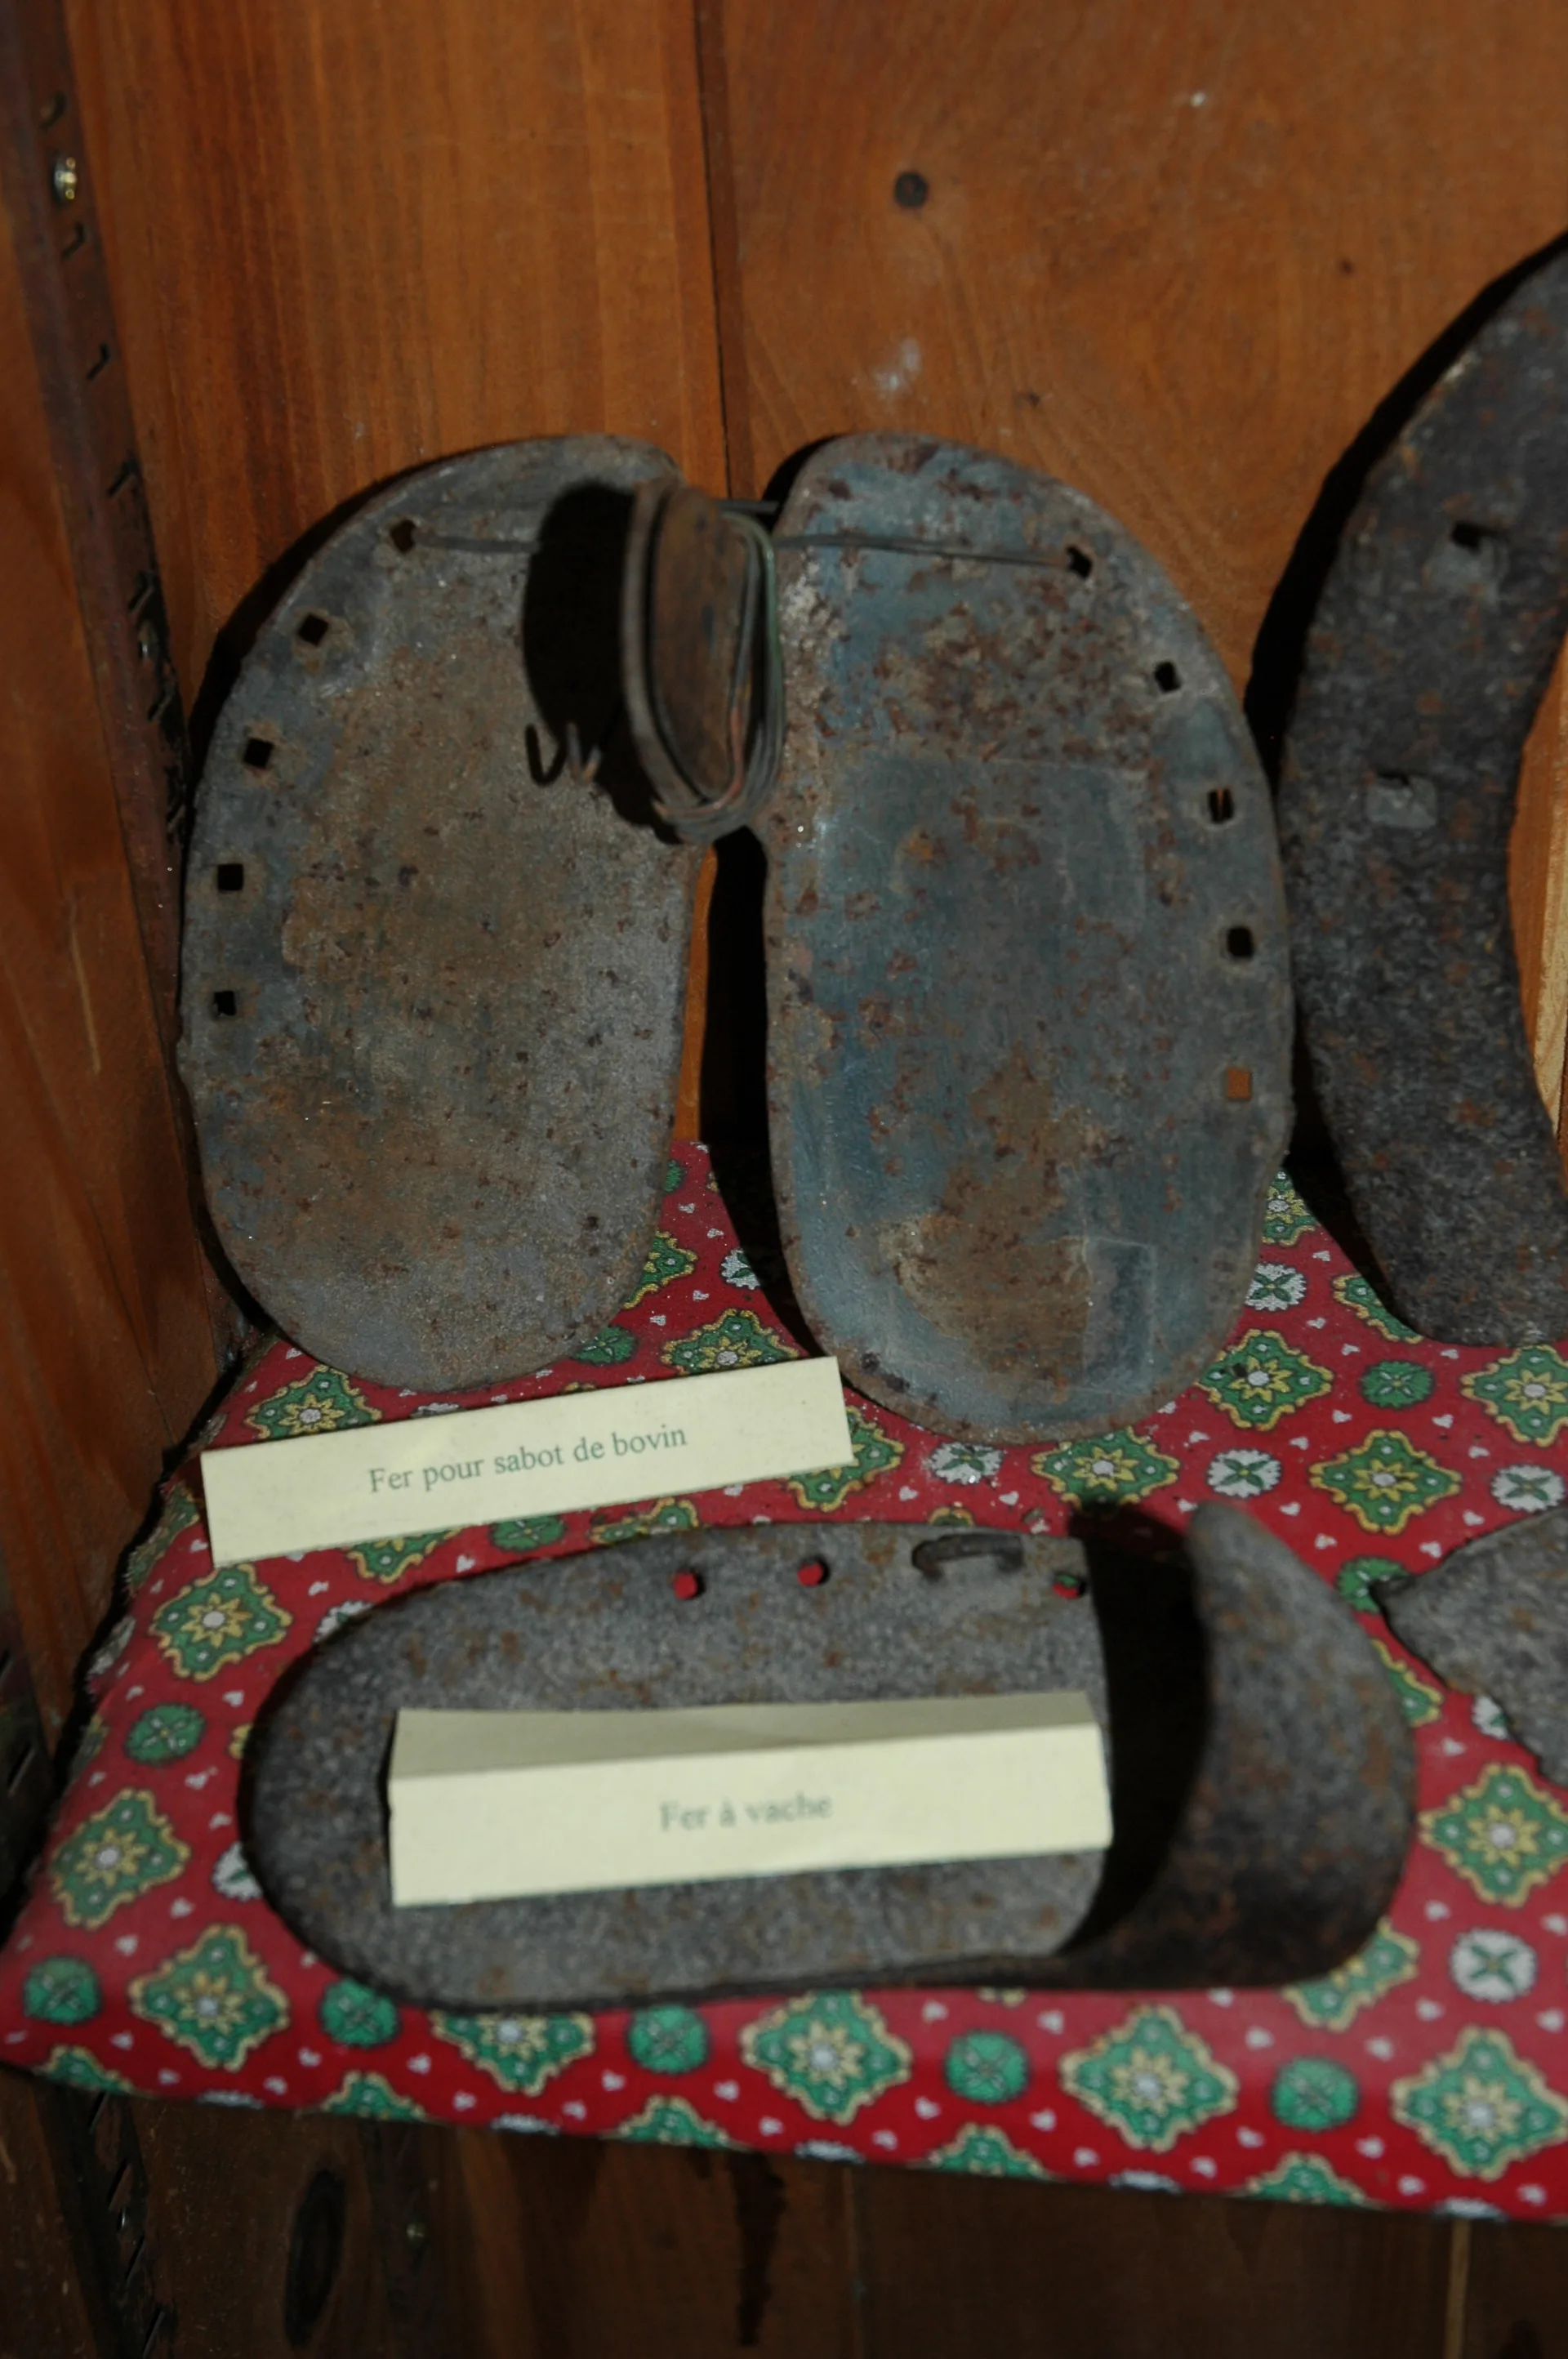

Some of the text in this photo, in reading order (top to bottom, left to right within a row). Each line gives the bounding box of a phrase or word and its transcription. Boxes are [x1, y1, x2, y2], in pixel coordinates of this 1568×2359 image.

[368, 1424, 688, 1493] Fer pour sabot de bovin
[659, 1800, 709, 1831] Fer
[745, 1791, 833, 1823] vache
